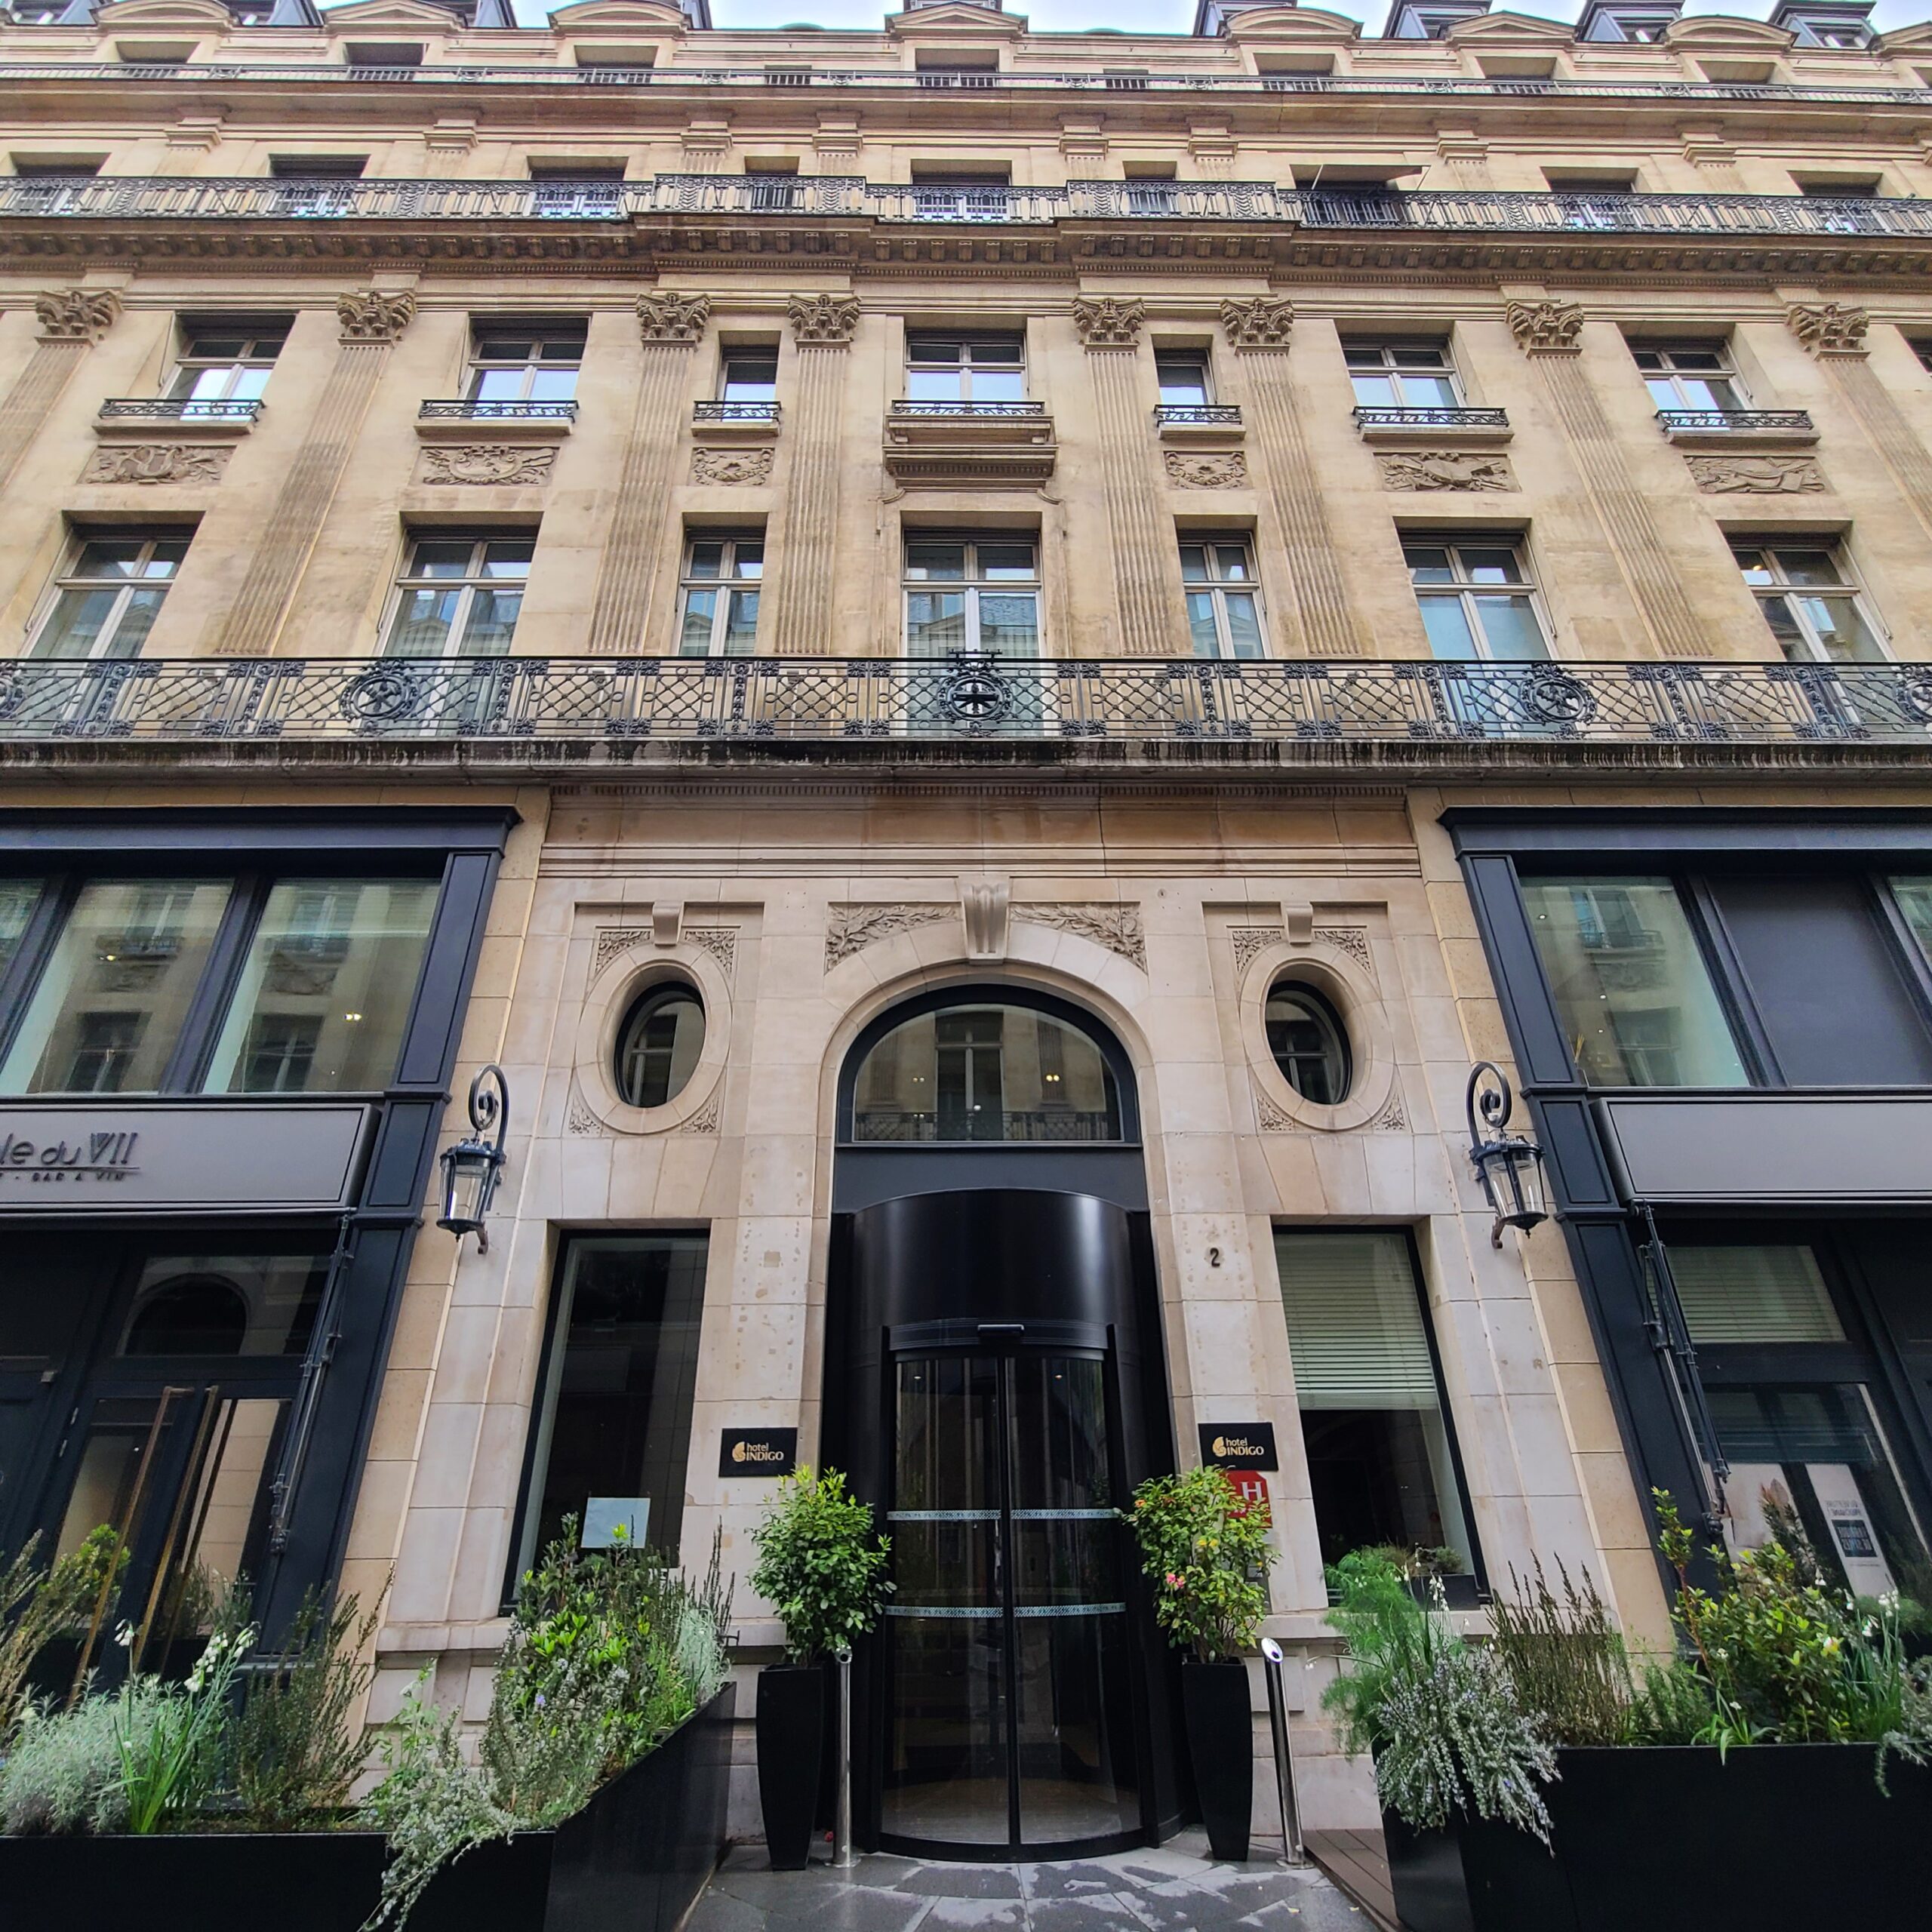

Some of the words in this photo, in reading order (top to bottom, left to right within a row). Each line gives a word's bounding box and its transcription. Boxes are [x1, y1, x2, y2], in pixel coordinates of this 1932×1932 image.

[41, 1140, 82, 1164] du
[90, 1132, 139, 1164] VII
[1210, 1247, 1220, 1268] 2
[746, 1442, 769, 1451] hotel
[1226, 1437, 1247, 1447] hotel
[746, 1451, 784, 1461] INDIGO
[1227, 1446, 1264, 1456] INDIGO
[1240, 1481, 1263, 1501] H
